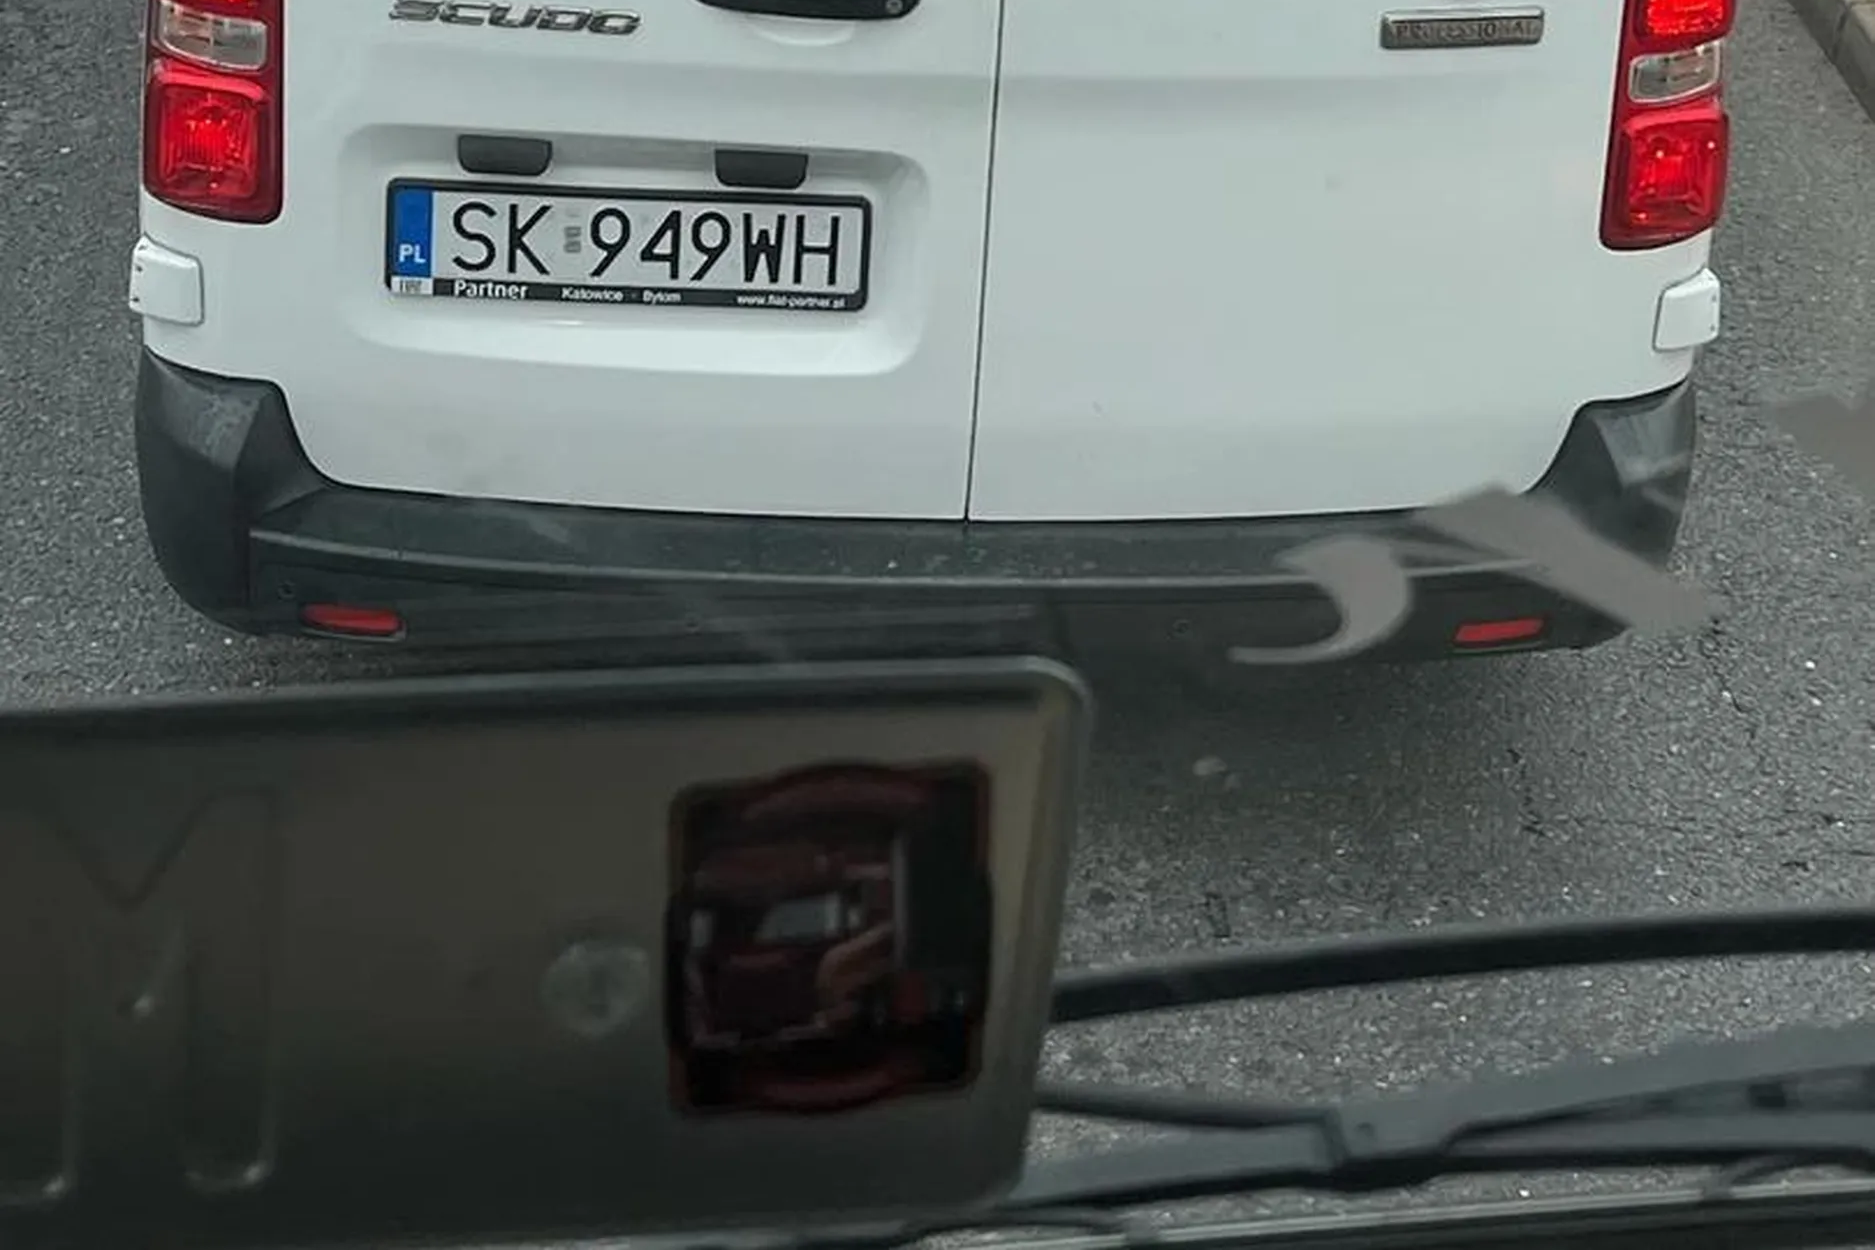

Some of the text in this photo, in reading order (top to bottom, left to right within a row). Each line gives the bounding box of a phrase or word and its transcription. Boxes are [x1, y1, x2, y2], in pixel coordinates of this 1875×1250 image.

[399, 243, 427, 265] PL
[452, 202, 841, 286] SK 949WH
[453, 279, 529, 300] Partner
[561, 287, 624, 302] Katowice
